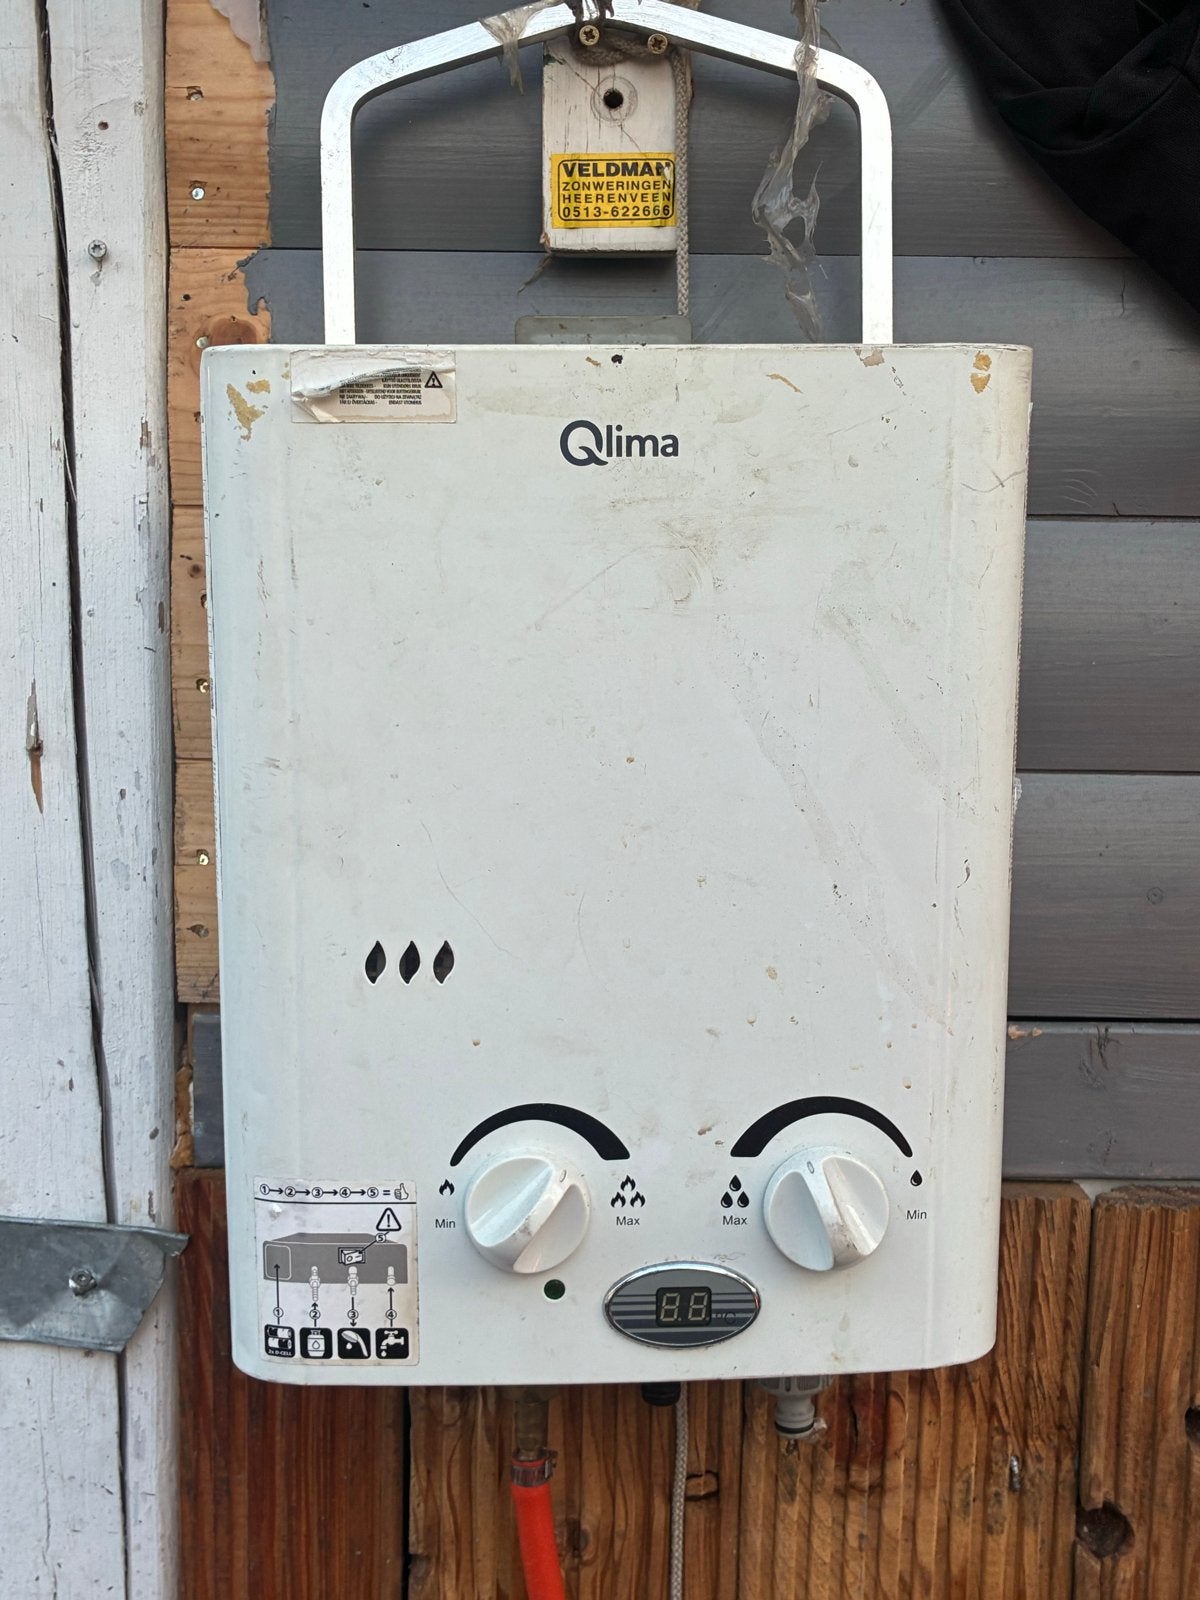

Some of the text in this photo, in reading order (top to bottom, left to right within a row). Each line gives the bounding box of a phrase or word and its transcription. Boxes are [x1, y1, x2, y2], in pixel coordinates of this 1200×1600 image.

[562, 161, 671, 177] VELDMAN
[562, 180, 671, 191] ZONWERINGEN
[562, 192, 671, 204] HEERENVEEN
[562, 205, 671, 218] 0513-622666
[560, 419, 679, 467] Qlima
[906, 1209, 928, 1220] Min
[435, 1218, 456, 1229] Min
[616, 1216, 640, 1226] Max
[722, 1215, 748, 1226] Max
